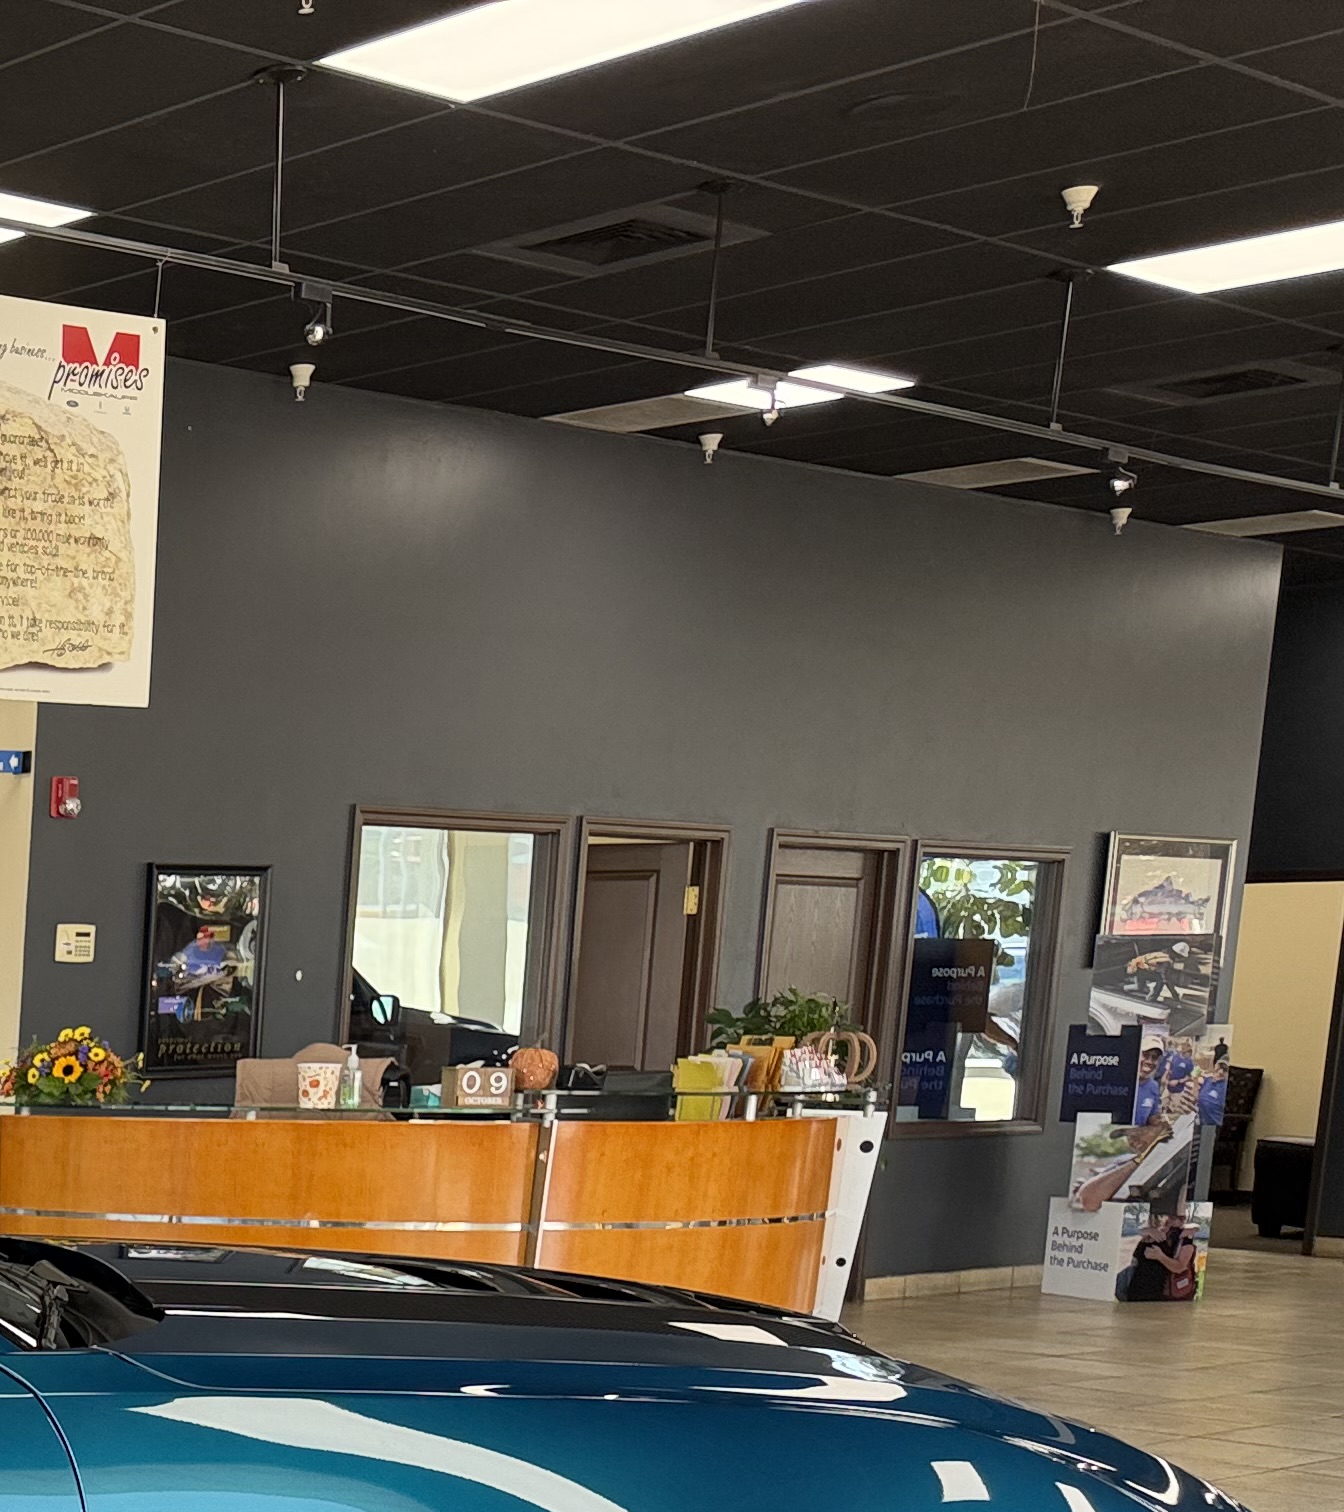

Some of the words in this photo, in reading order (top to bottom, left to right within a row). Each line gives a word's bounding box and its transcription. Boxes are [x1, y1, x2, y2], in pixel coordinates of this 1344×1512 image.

[47, 353, 150, 401] promises
[5, 559, 20, 574] for
[102, 619, 117, 634] for
[157, 1042, 241, 1059] protection
[1069, 1052, 1079, 1065] A
[1079, 1052, 1120, 1068] Purpose
[1069, 1067, 1103, 1080] Behind
[1067, 1082, 1085, 1095] the
[1085, 1082, 1129, 1097] Purchase
[1052, 1225, 1059, 1237] A
[1061, 1226, 1100, 1241] Purpose
[1050, 1240, 1084, 1255] Behind
[1049, 1255, 1065, 1268] the
[1066, 1256, 1110, 1273] Purchase
